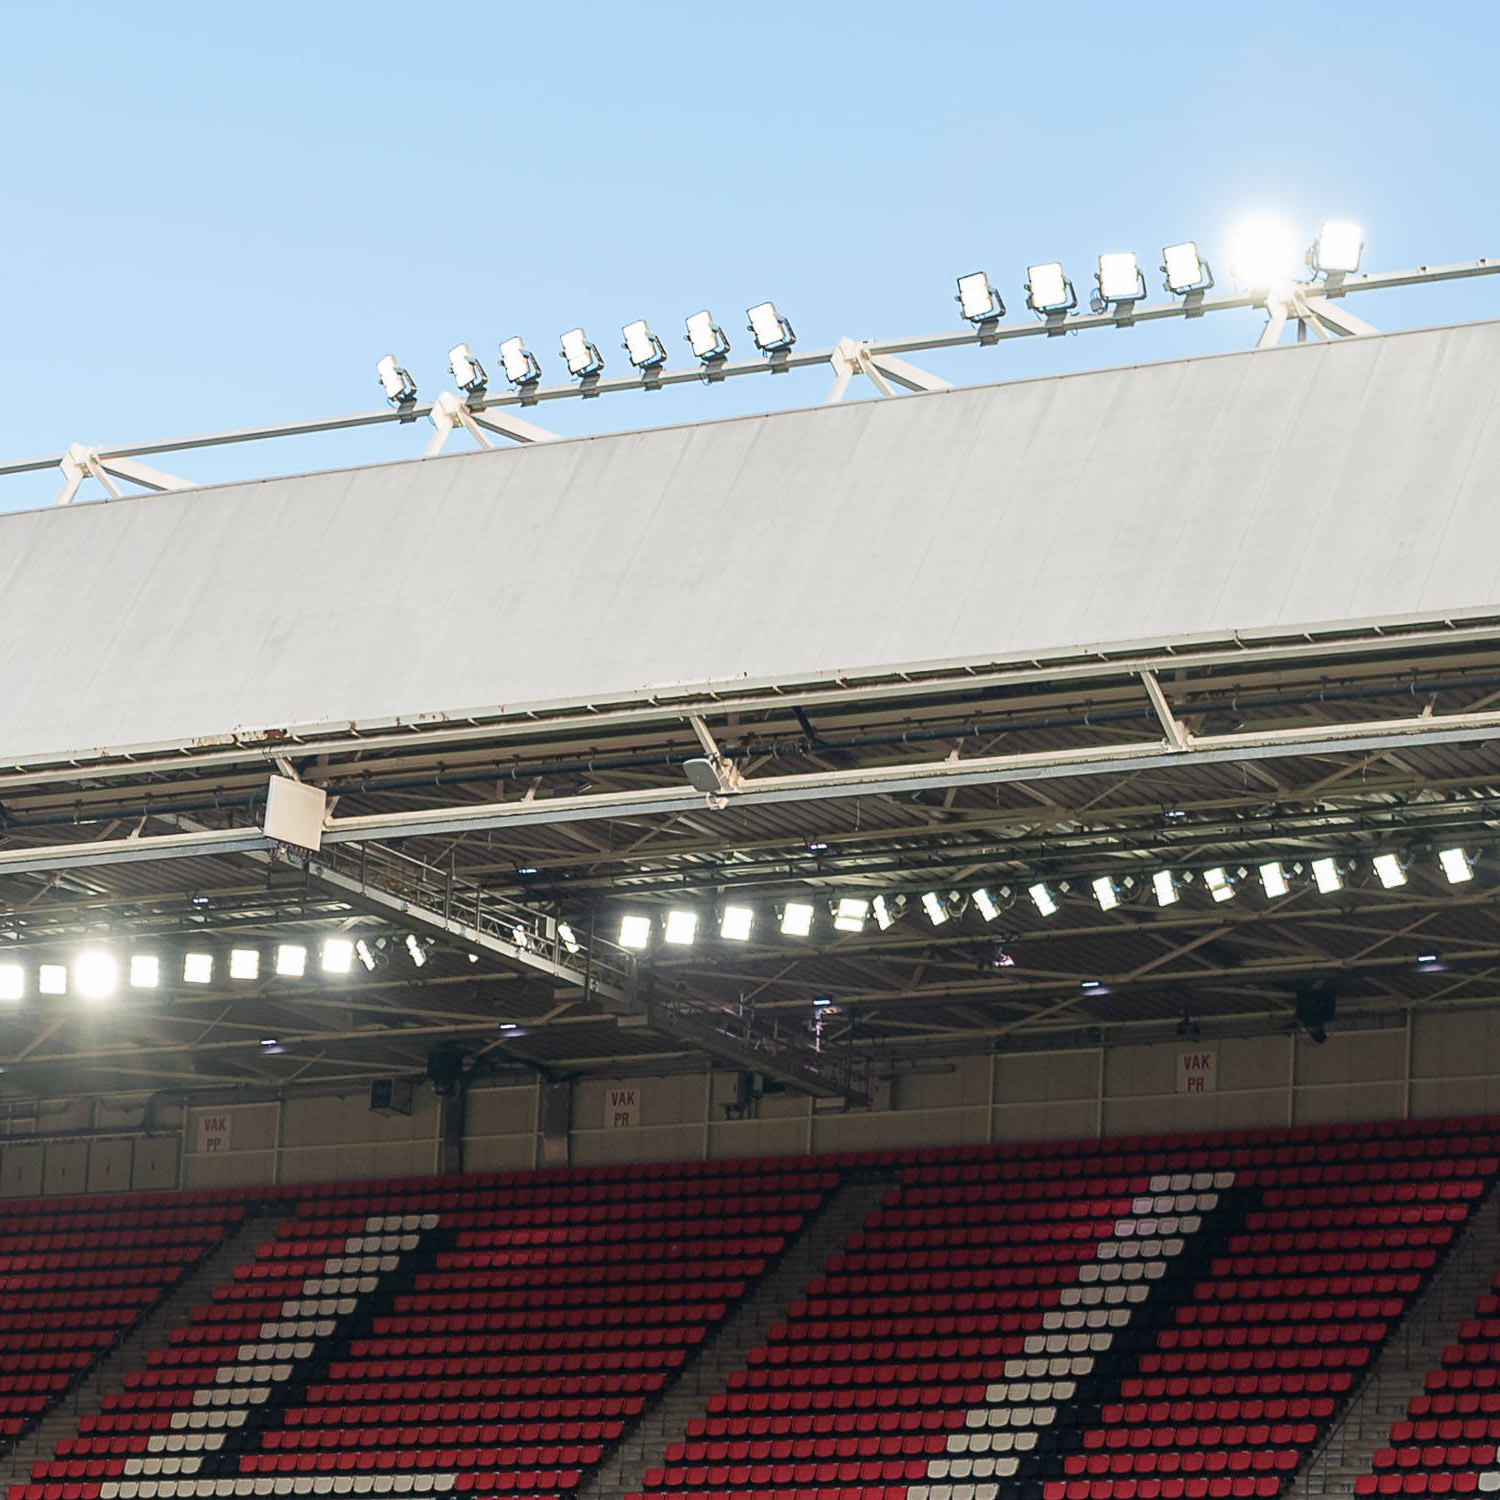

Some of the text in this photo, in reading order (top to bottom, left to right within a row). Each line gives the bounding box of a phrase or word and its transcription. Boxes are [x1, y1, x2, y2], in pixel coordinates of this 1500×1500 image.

[1184, 1055, 1211, 1070] VAK
[1187, 1077, 1205, 1092] PR
[611, 1091, 636, 1106] VAK
[204, 1118, 226, 1132] VAK
